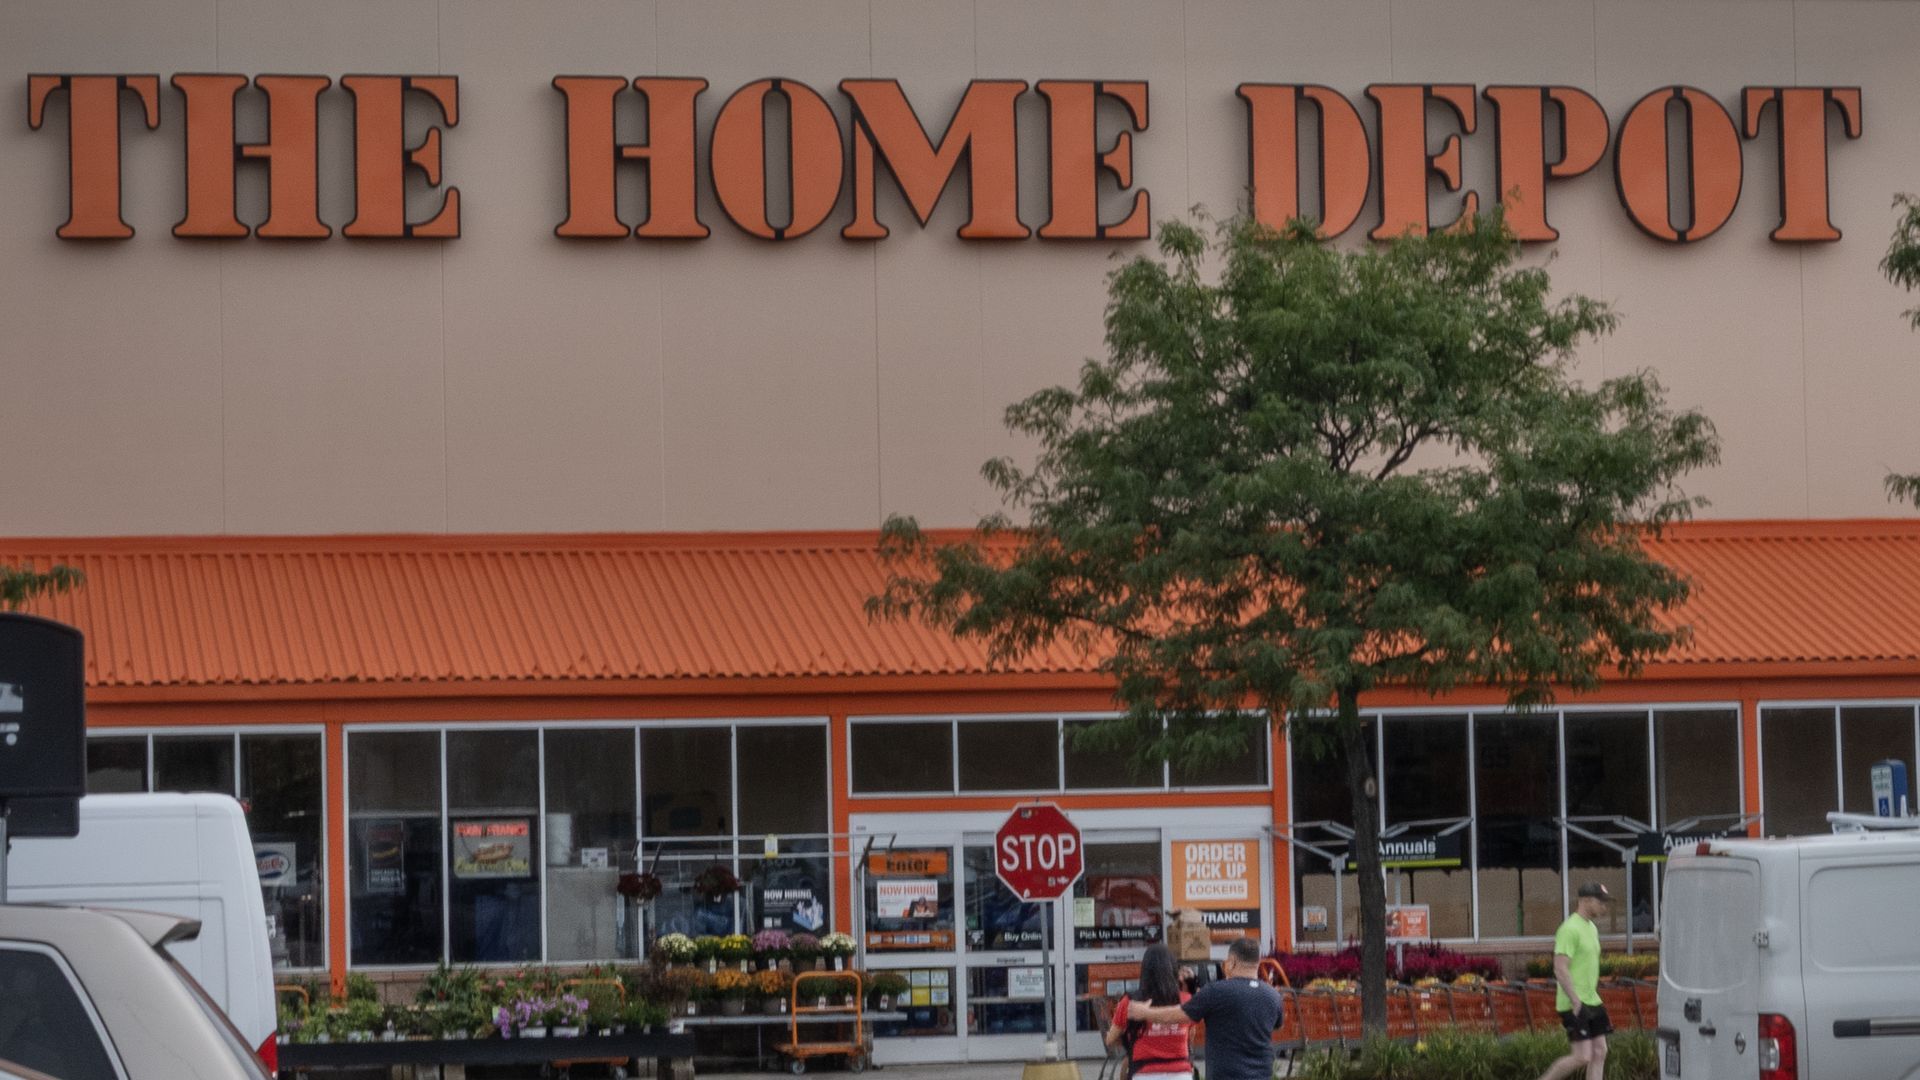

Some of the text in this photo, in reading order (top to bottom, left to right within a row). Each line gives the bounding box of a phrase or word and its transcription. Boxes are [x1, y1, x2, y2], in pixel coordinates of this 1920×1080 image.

[28, 73, 1862, 245] THE HOME DEPOT
[1002, 833, 1076, 871] STOP
[1185, 843, 1246, 862] ORDER
[1378, 839, 1436, 855] Annuals
[886, 858, 929, 873] Enter
[1187, 862, 1247, 879] PICK UP
[764, 889, 812, 900] NOW HIRING
[880, 883, 937, 895] NOW HIRING
[1189, 884, 1245, 895] LOCKERS
[1203, 911, 1248, 924] TRANCE
[1004, 931, 1042, 942] Buy Onlin
[1080, 929, 1143, 940] Pick Up In Store
